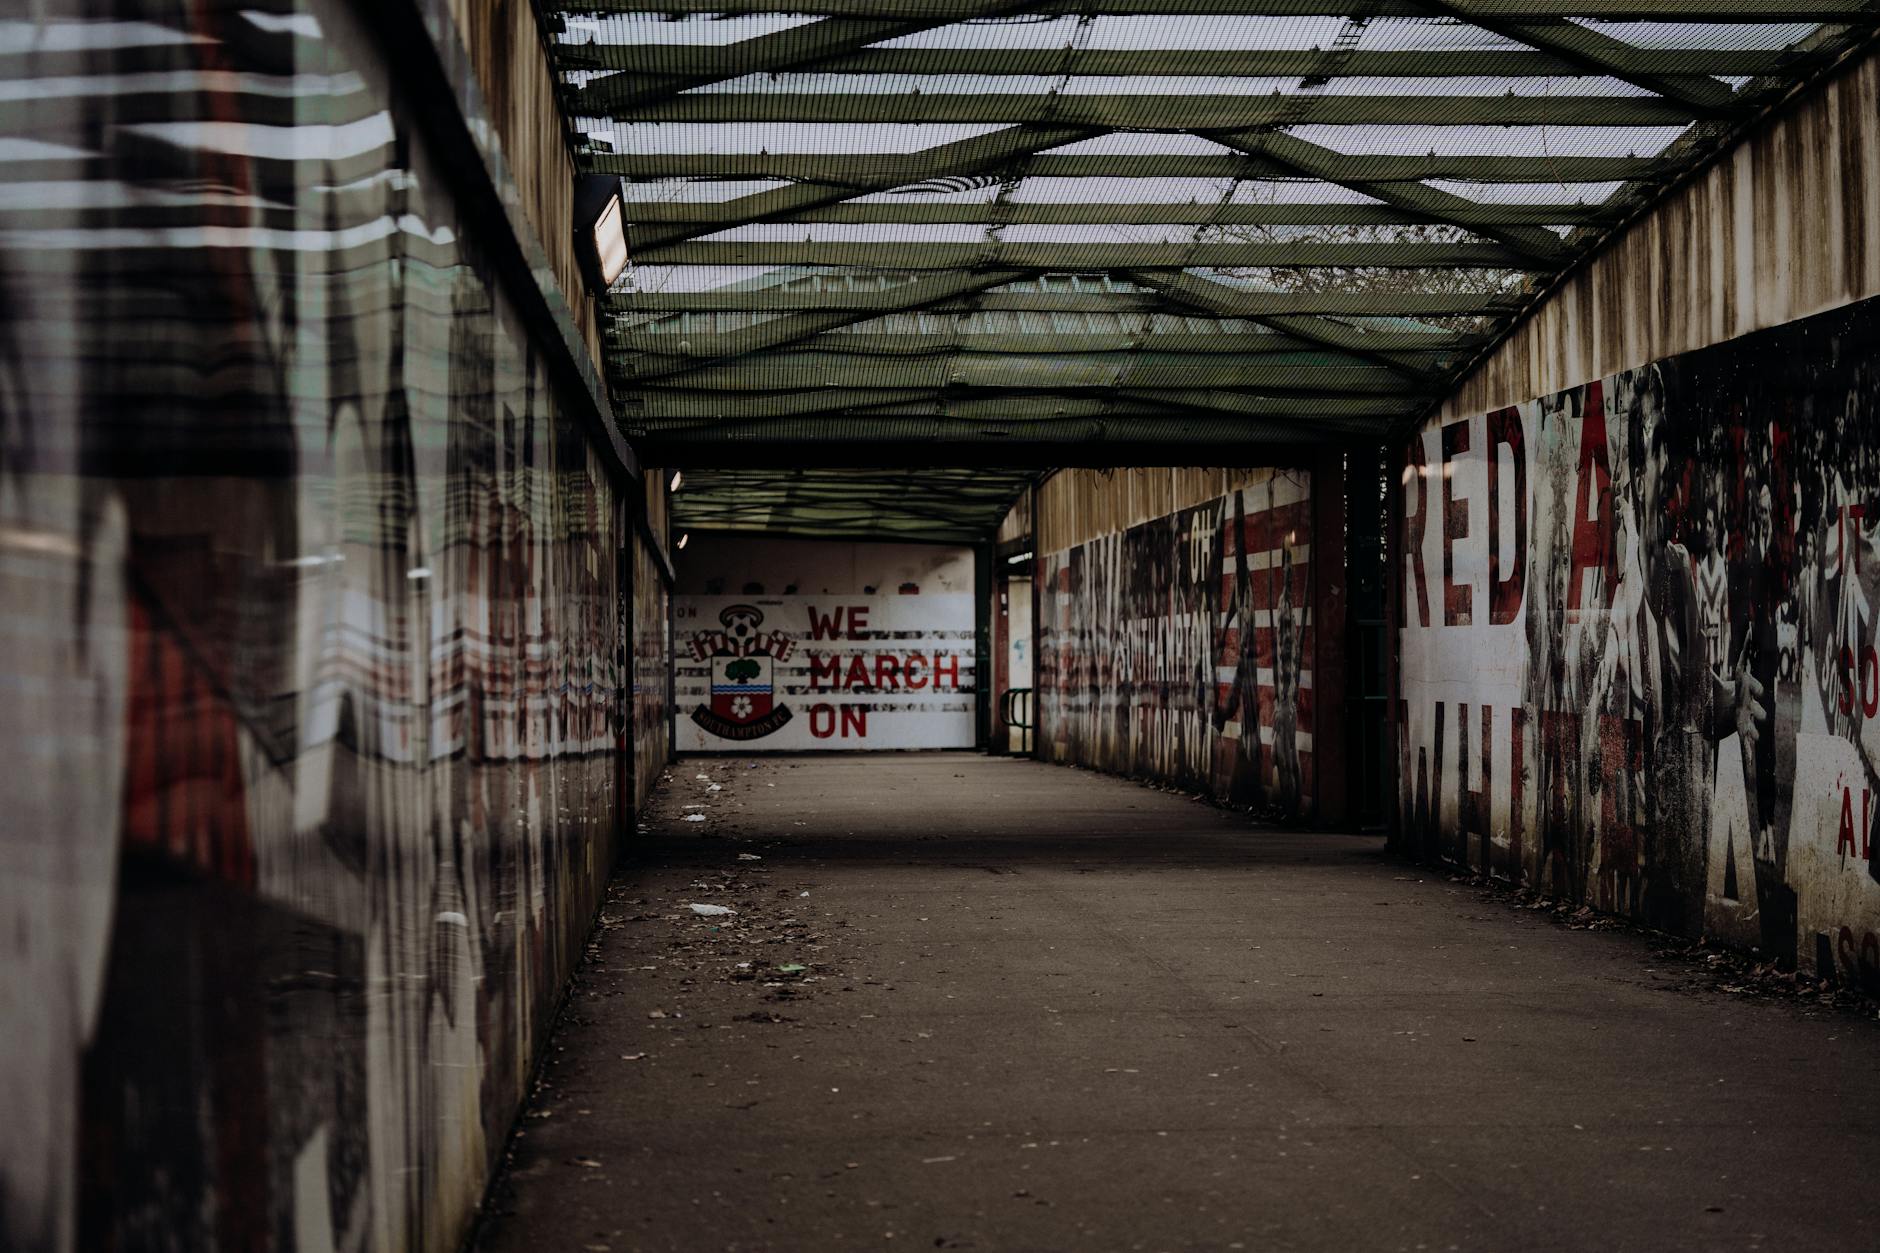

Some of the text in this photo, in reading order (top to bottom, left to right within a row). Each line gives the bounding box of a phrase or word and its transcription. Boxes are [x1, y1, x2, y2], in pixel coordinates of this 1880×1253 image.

[1190, 509, 1211, 584] OH
[1400, 405, 1528, 628] RED
[808, 606, 869, 640] WE
[1118, 609, 1213, 684] SOUTHAMPTON
[810, 654, 958, 689] MARCH
[697, 710, 774, 738] SOUTHAMPTON
[810, 703, 866, 738] ON
[1129, 706, 1213, 780] WE LOVE YOU
[1399, 699, 1644, 914] WHITE
